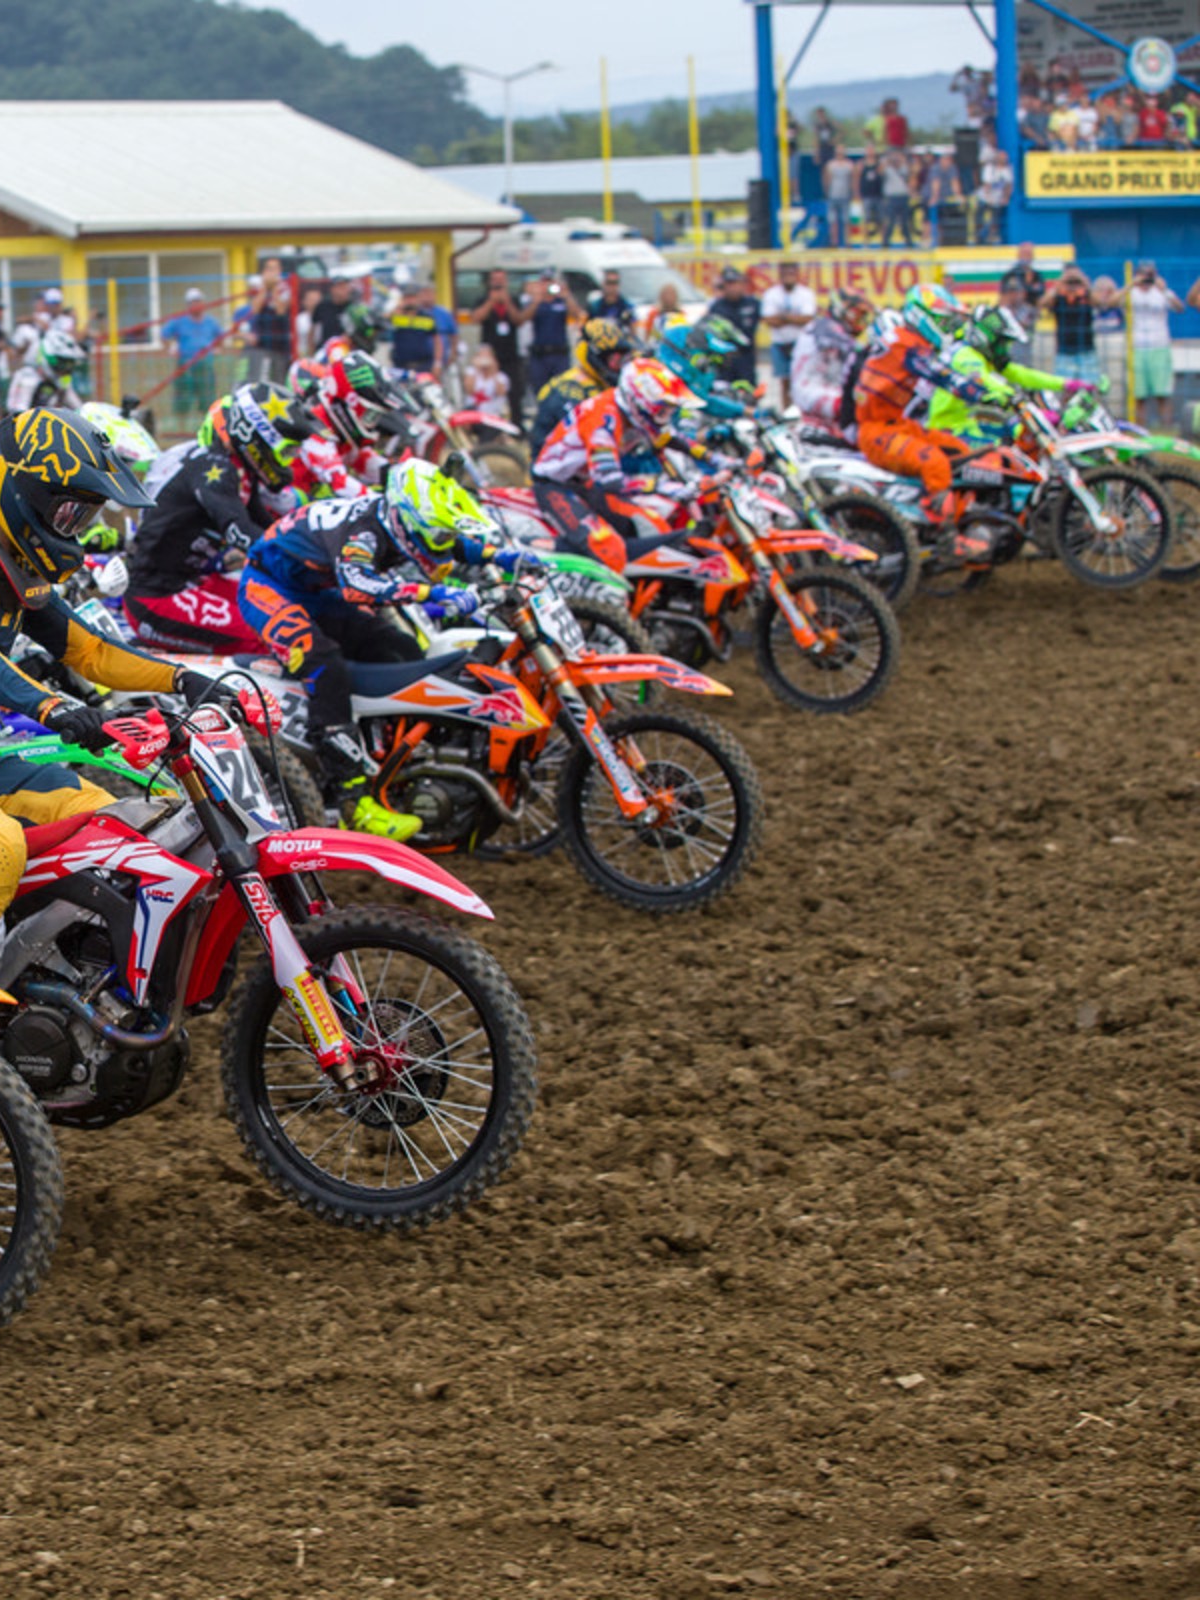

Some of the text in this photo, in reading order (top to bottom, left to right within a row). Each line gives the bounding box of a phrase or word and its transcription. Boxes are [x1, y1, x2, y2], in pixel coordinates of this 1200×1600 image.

[1039, 172, 1200, 190] GRAND PRIX BU
